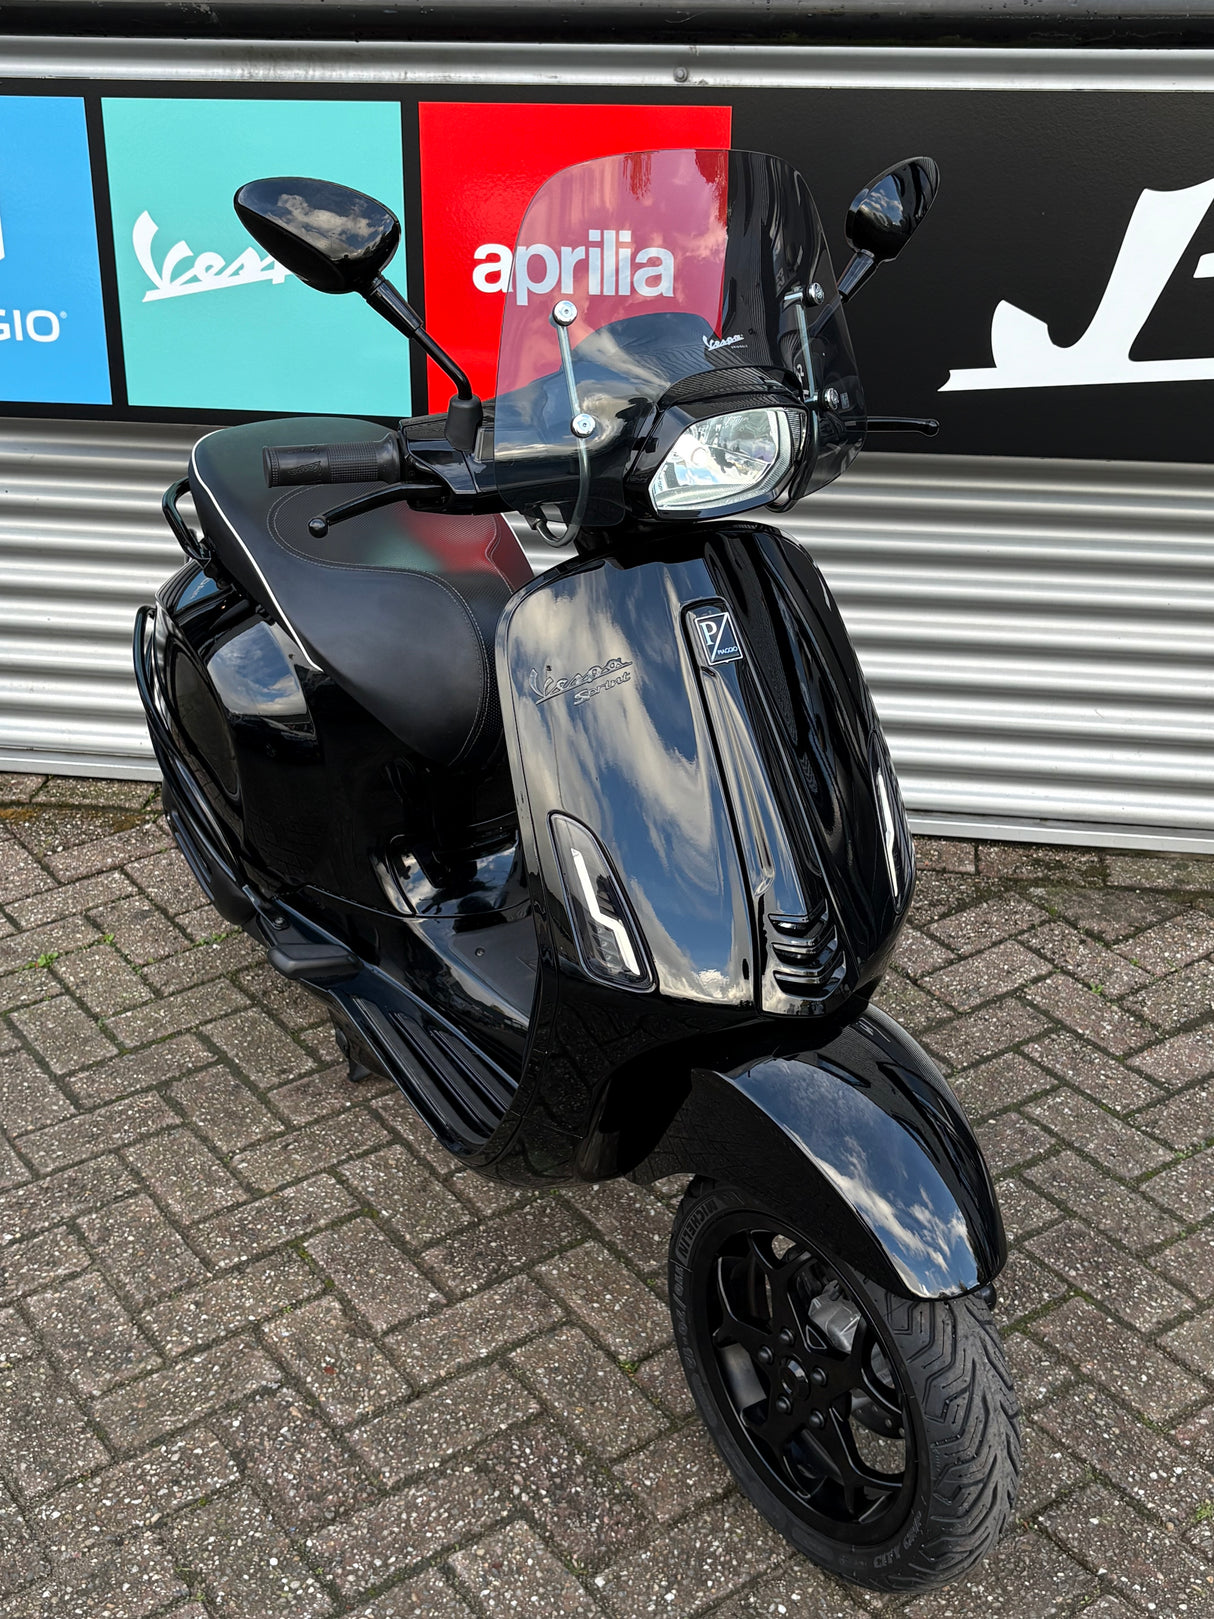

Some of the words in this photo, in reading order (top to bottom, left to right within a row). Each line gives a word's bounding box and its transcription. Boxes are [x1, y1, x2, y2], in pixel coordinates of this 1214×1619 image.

[472, 229, 675, 306] aprilia
[702, 334, 745, 352] Vespa
[699, 621, 717, 646] P
[528, 656, 633, 705] Vespa
[573, 670, 632, 707] Sprint
[677, 1198, 719, 1259] MICHELIN
